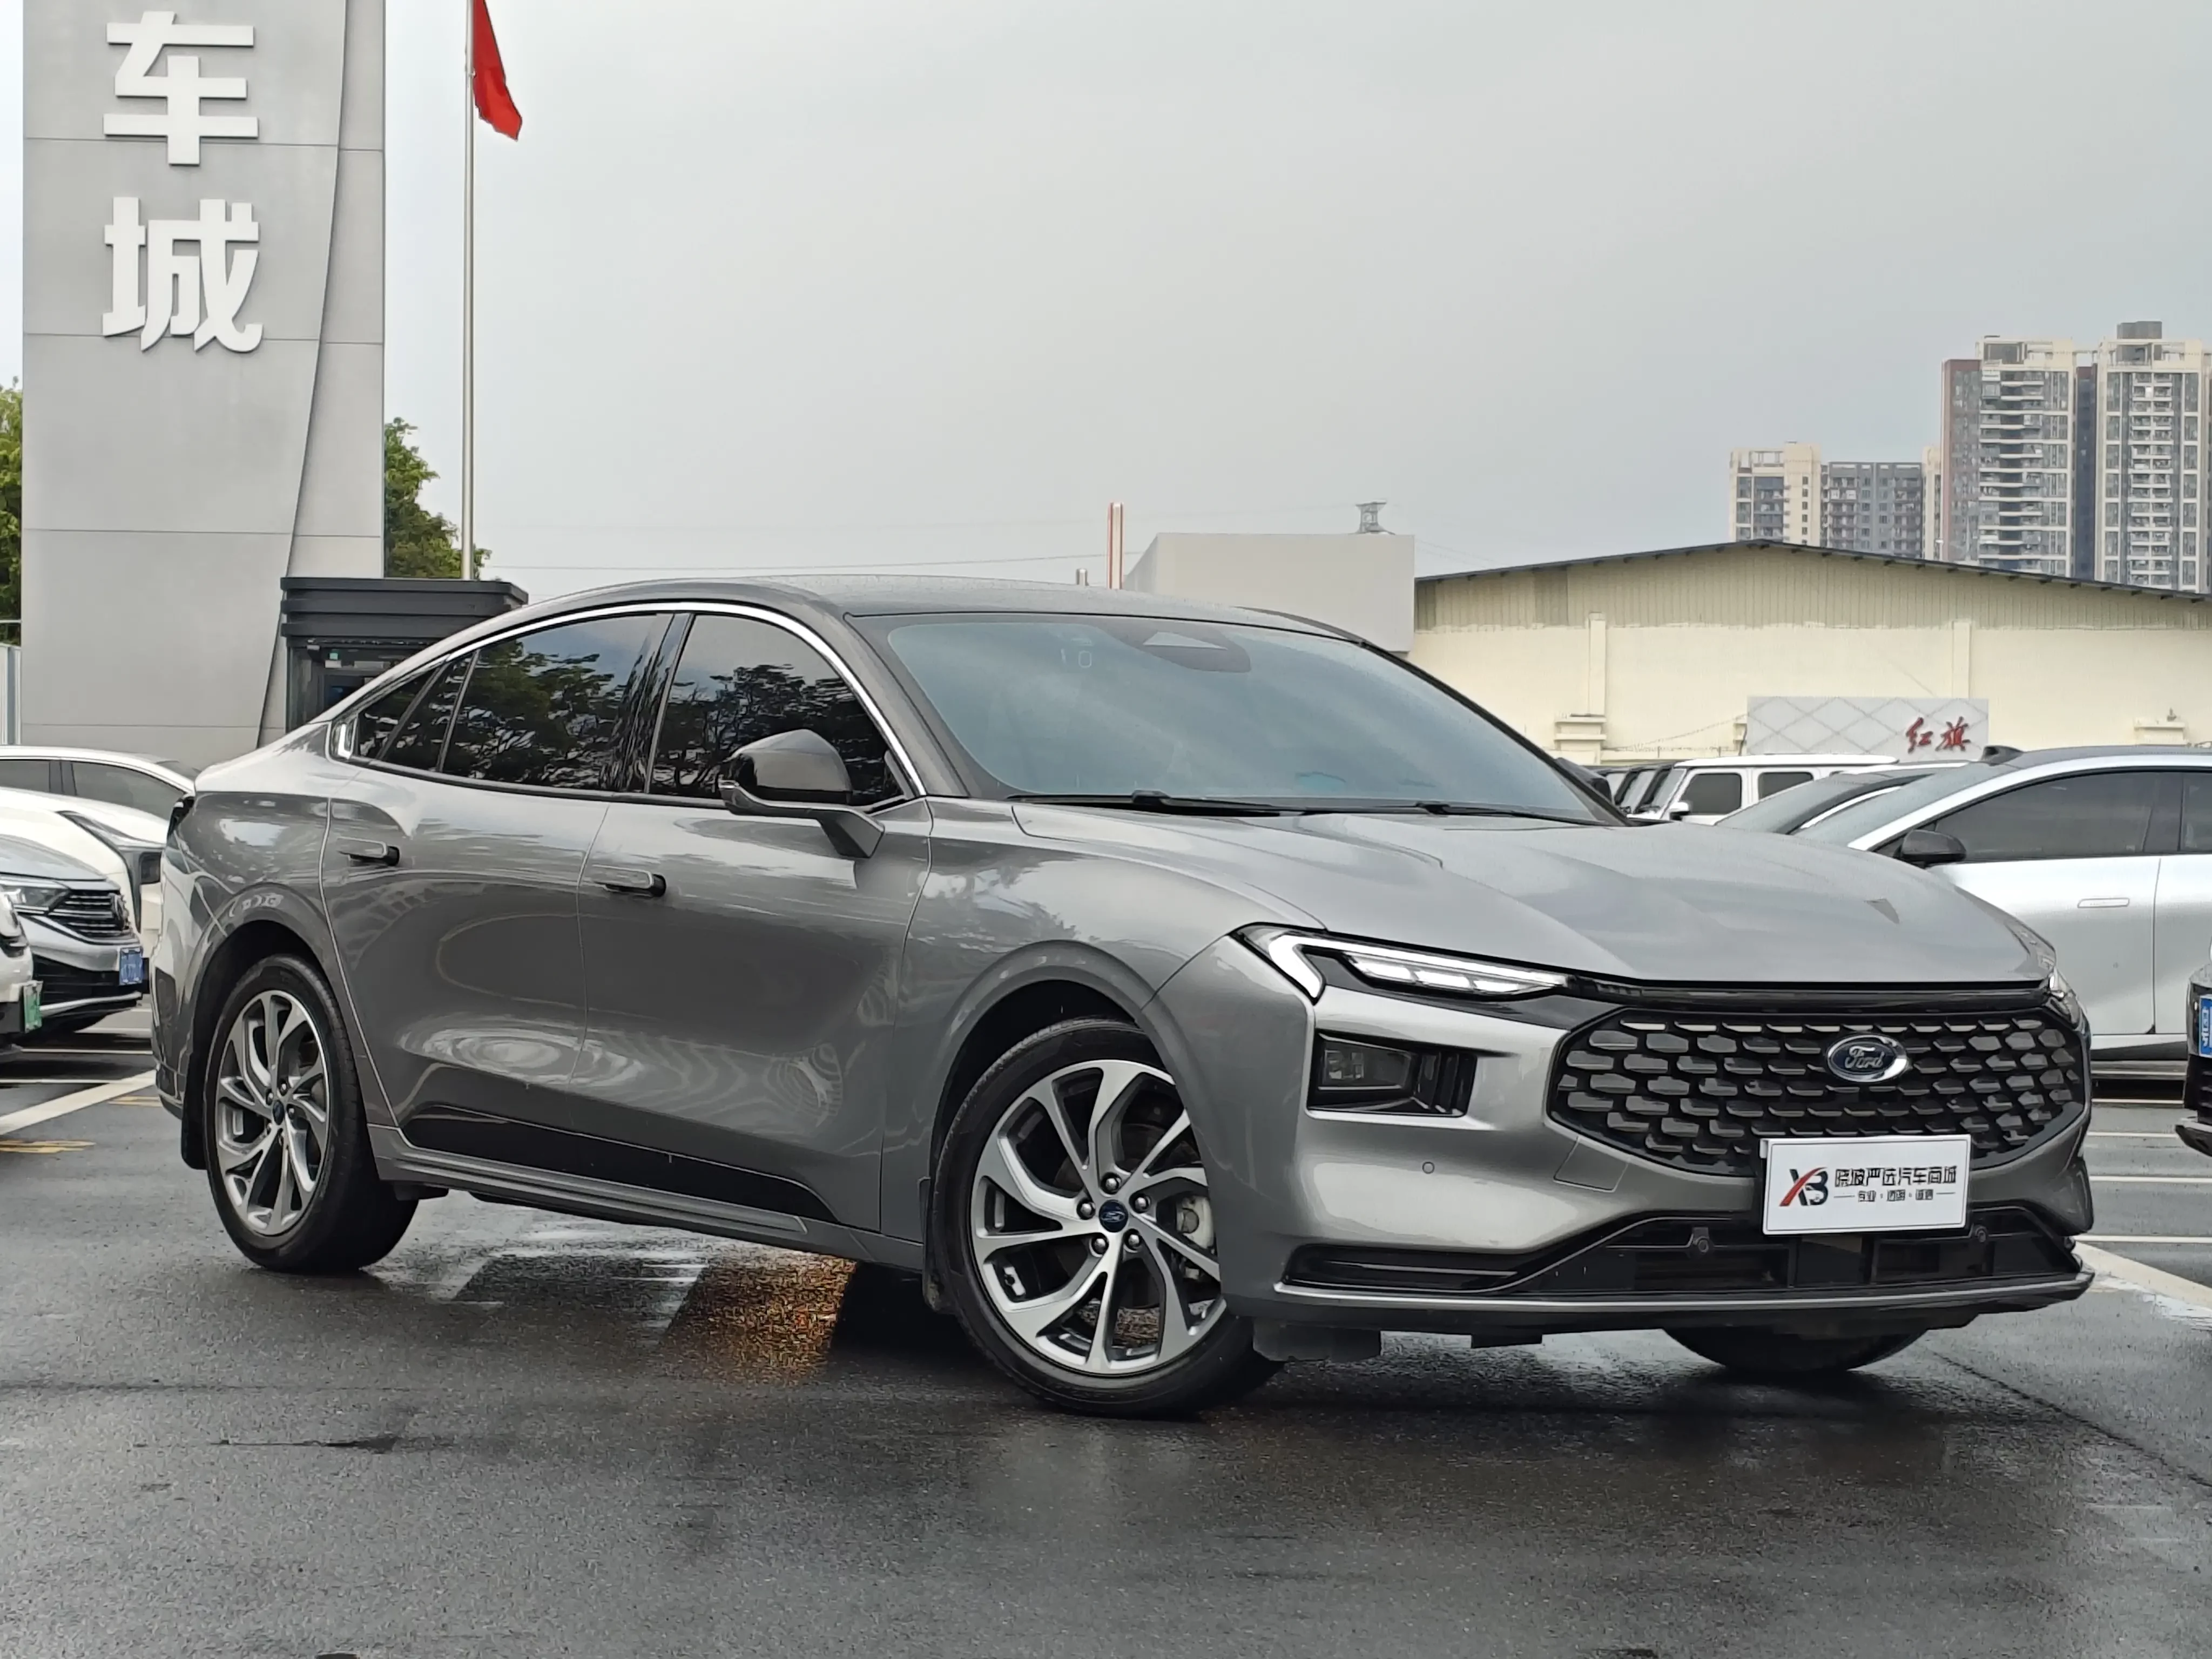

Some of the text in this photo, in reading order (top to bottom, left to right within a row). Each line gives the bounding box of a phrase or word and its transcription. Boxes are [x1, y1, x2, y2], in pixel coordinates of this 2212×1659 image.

[103, 11, 263, 353] 车城
[1905, 716, 1972, 753] 红旗
[1845, 1046, 1885, 1069] Ford
